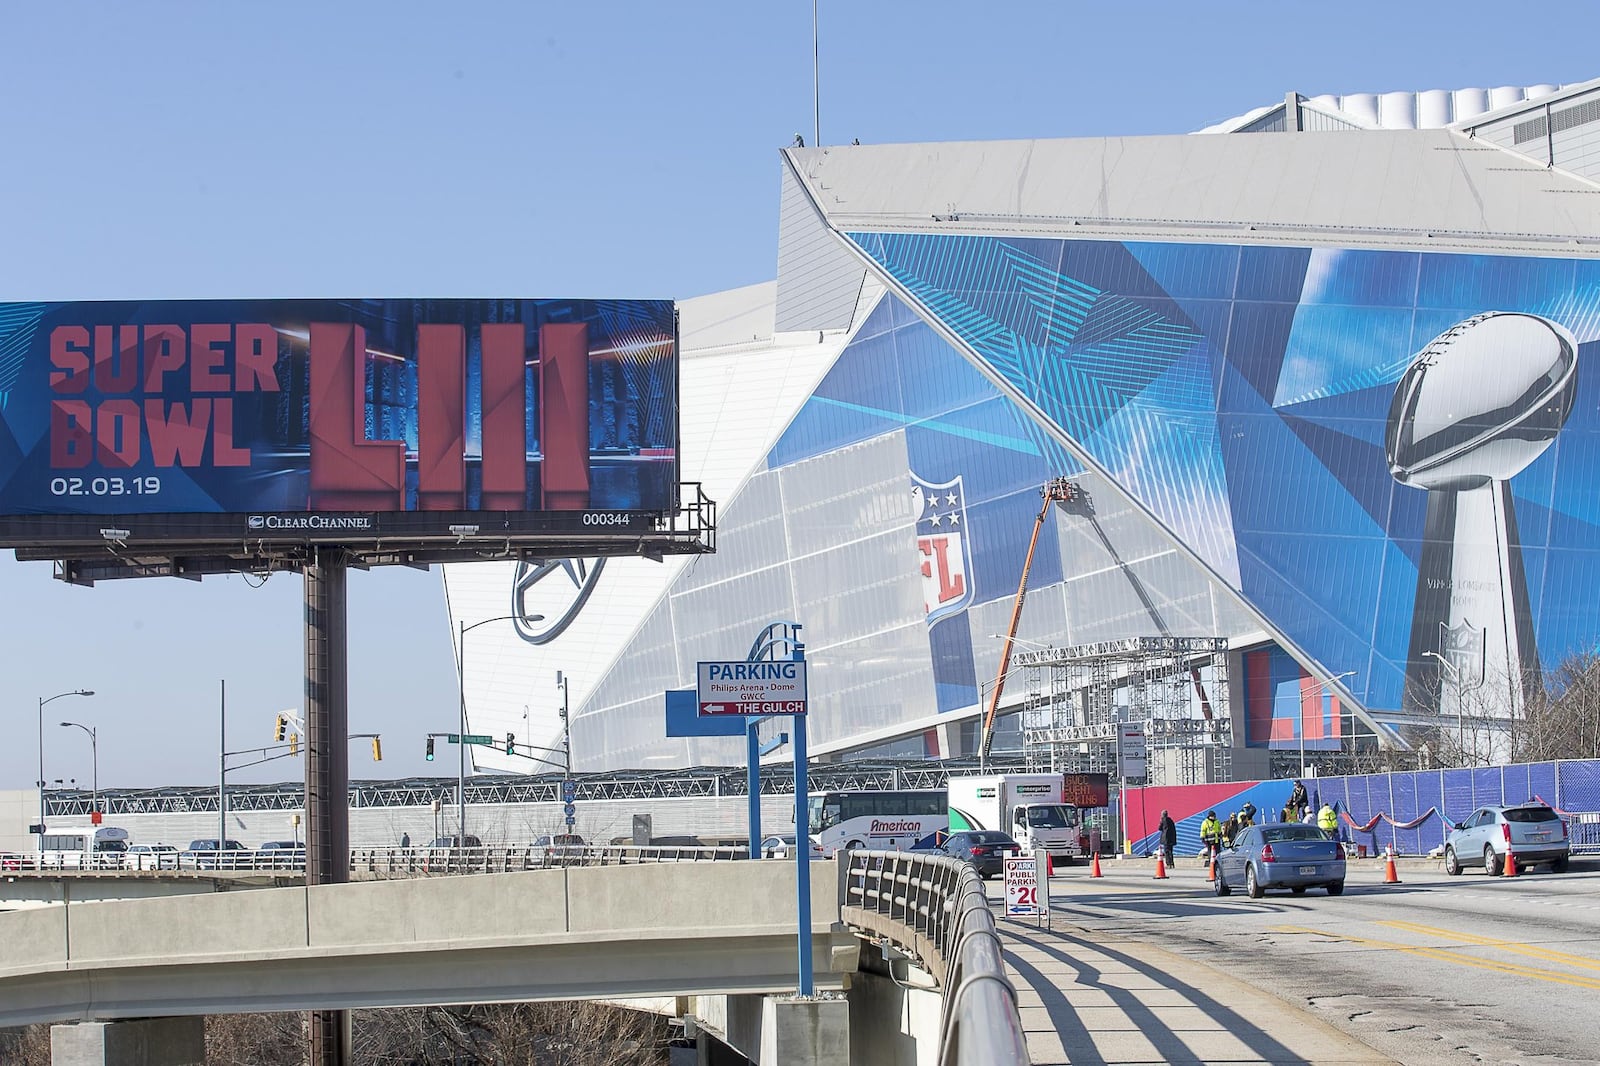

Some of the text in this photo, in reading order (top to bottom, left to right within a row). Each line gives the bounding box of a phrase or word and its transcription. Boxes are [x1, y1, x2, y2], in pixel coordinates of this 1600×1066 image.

[49, 323, 280, 393] SUPER
[309, 322, 590, 511] LIII
[50, 397, 251, 468] BOWL
[50, 476, 160, 496] 02.03.19
[582, 513, 630, 526] 000344
[709, 663, 796, 680] PARKING
[711, 684, 738, 693] Philips
[770, 683, 795, 691] Dome
[736, 702, 804, 713] THE GULCH
[1017, 785, 1051, 793] enterprise
[870, 818, 921, 832] American
